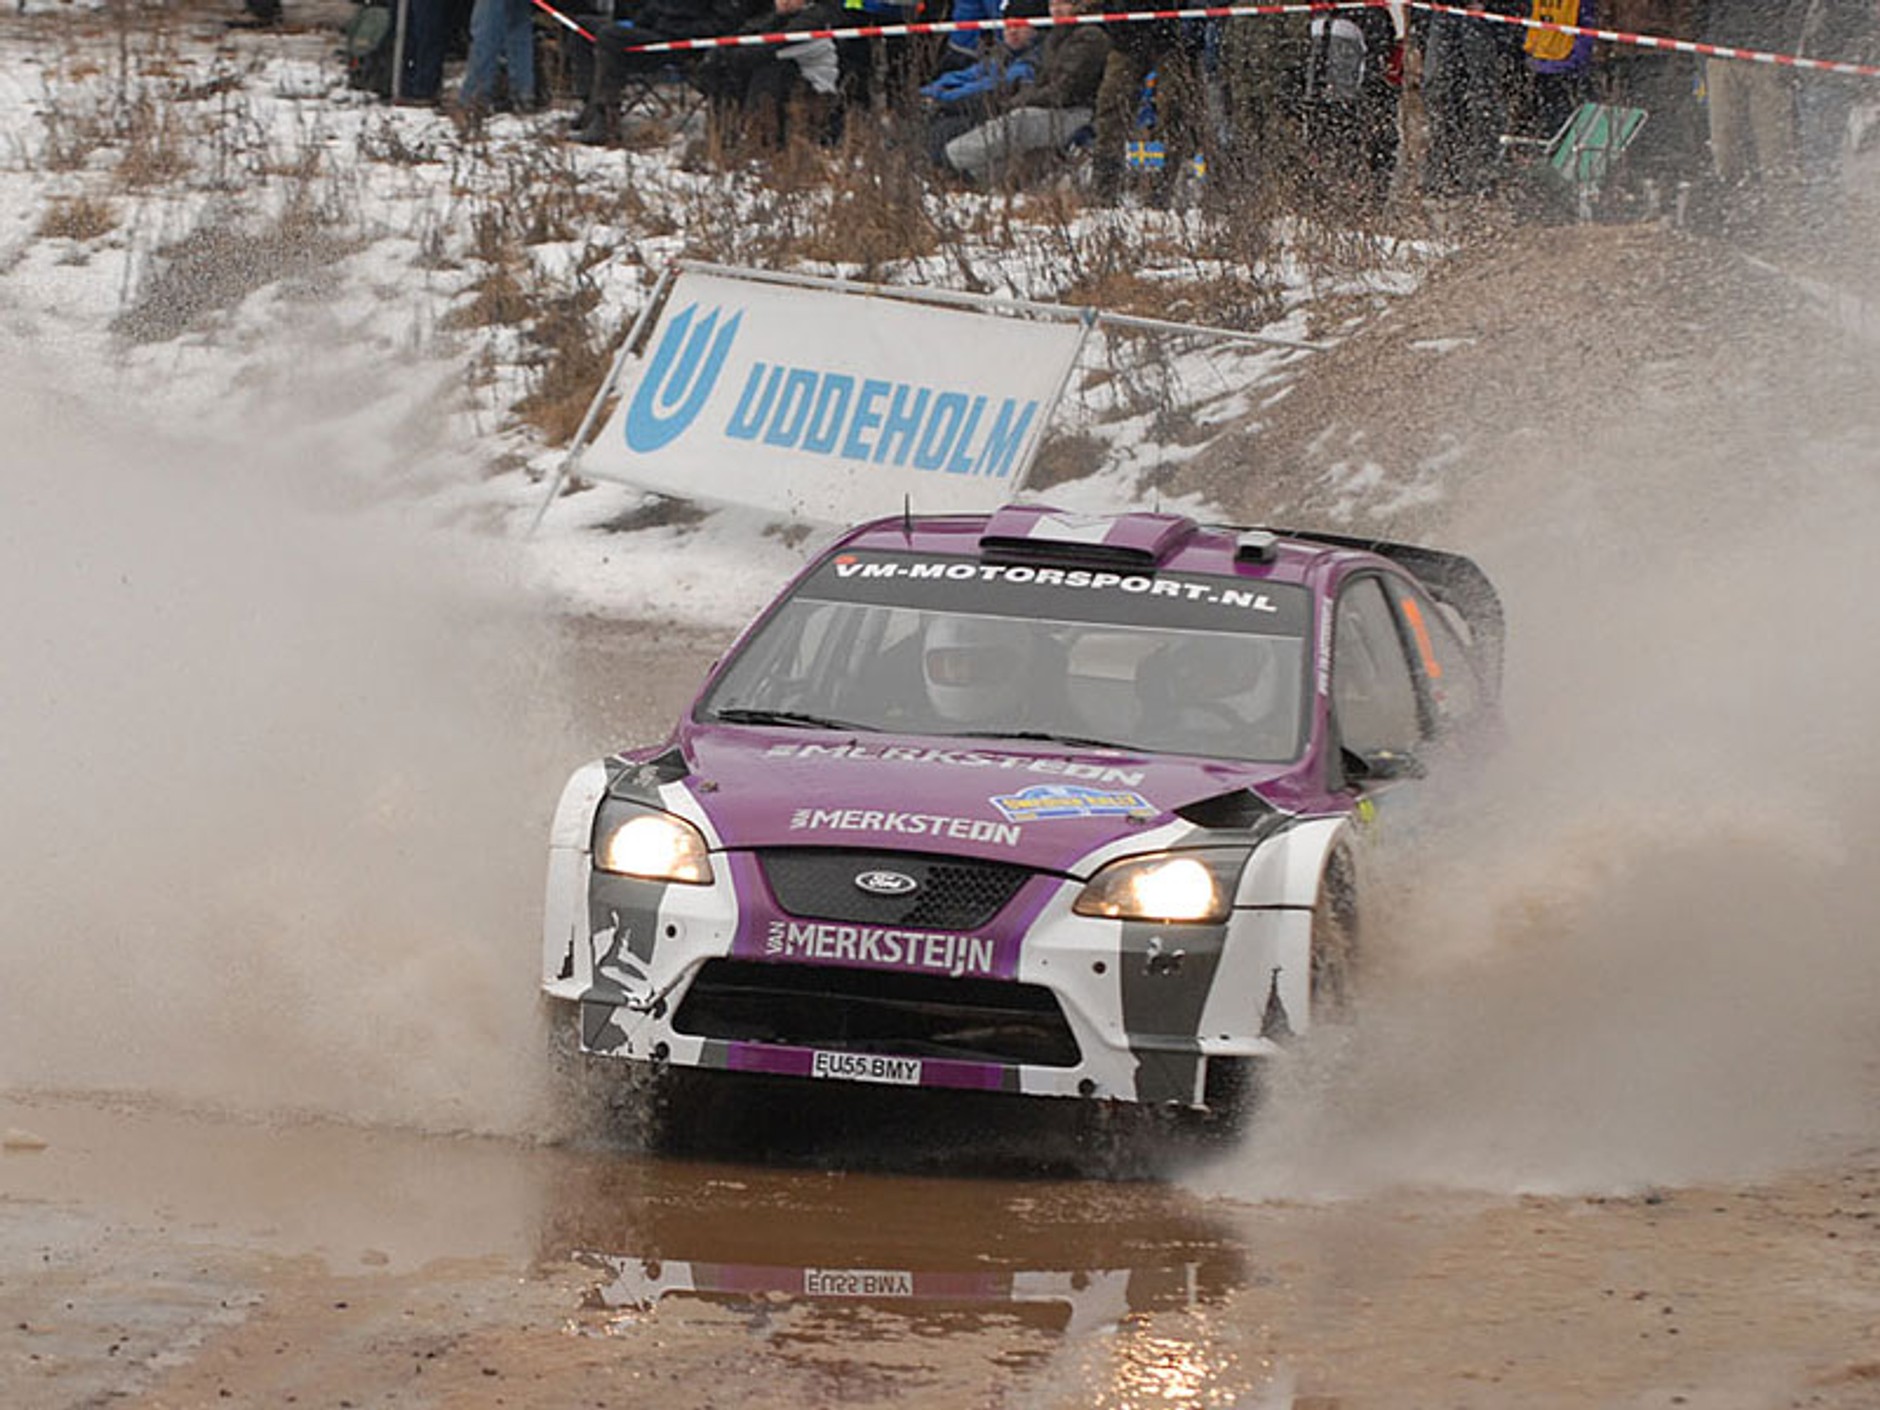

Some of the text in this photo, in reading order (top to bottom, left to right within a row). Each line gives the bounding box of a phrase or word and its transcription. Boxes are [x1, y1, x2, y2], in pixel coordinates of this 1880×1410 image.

[725, 362, 1039, 478] UDDEHOLM
[835, 562, 1278, 614] VM-MOTORSPORT.NL
[784, 922, 995, 978] MERKSTEIJN
[815, 1053, 919, 1080] EU55 BMY
